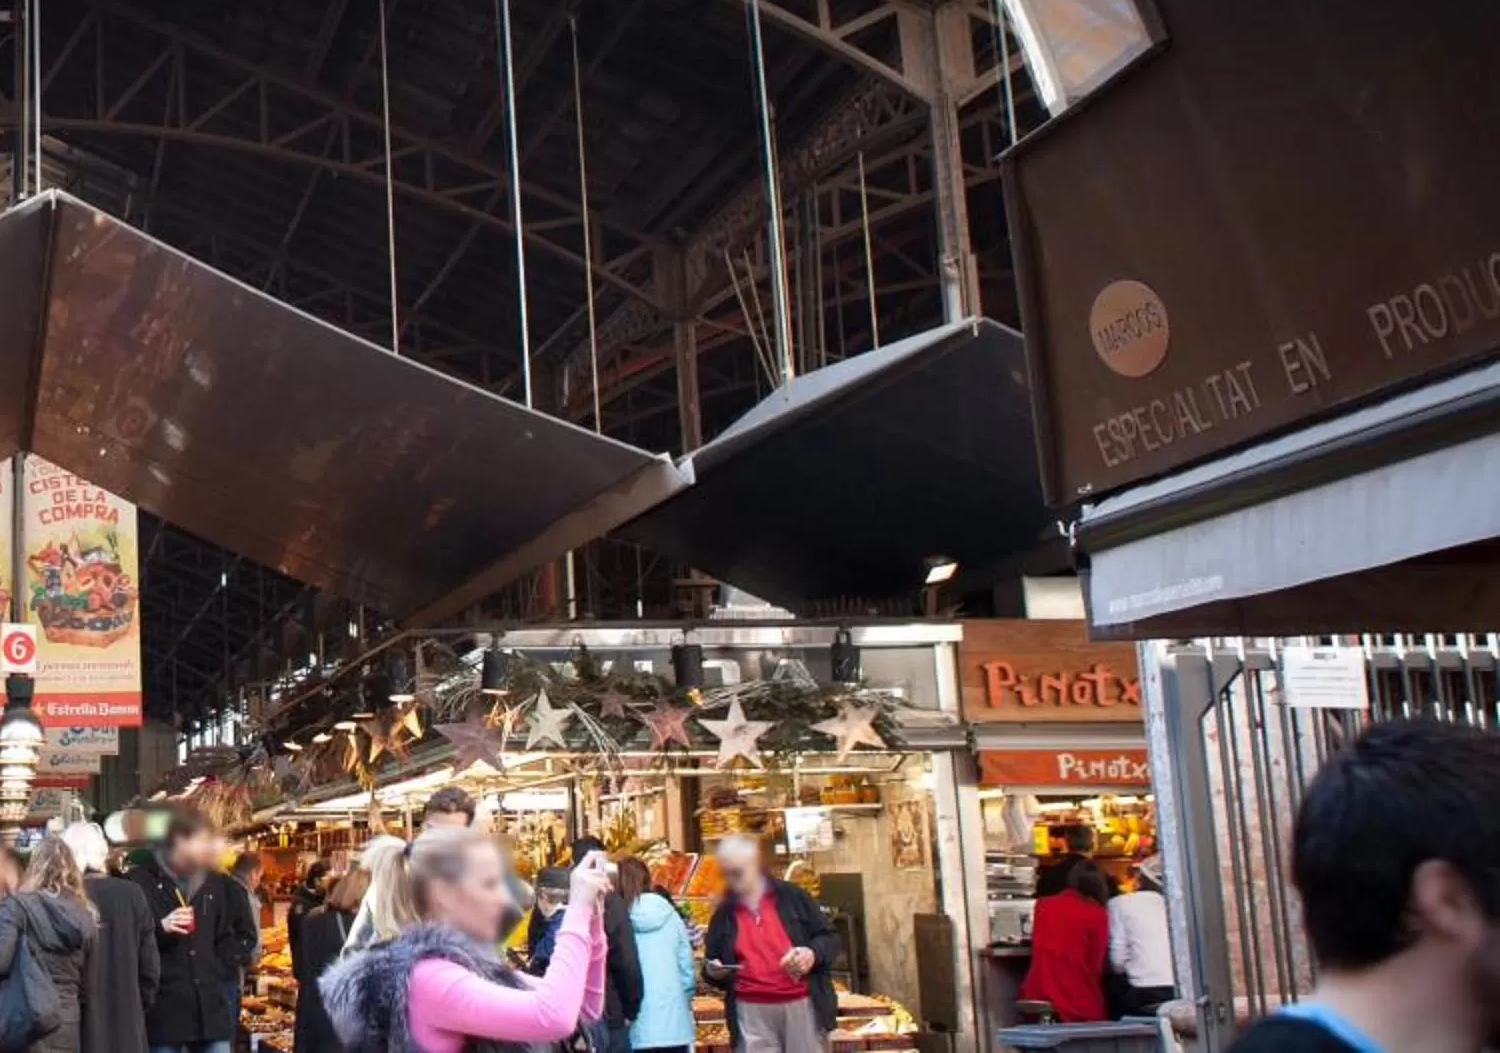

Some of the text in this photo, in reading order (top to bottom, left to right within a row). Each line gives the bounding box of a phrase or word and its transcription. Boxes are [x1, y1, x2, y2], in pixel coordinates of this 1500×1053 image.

[1278, 330, 1333, 394] EN
[52, 489, 106, 504] DE LA
[39, 504, 118, 525] COMPRA
[11, 637, 28, 659] 6
[47, 701, 138, 716] Estrella Damm
